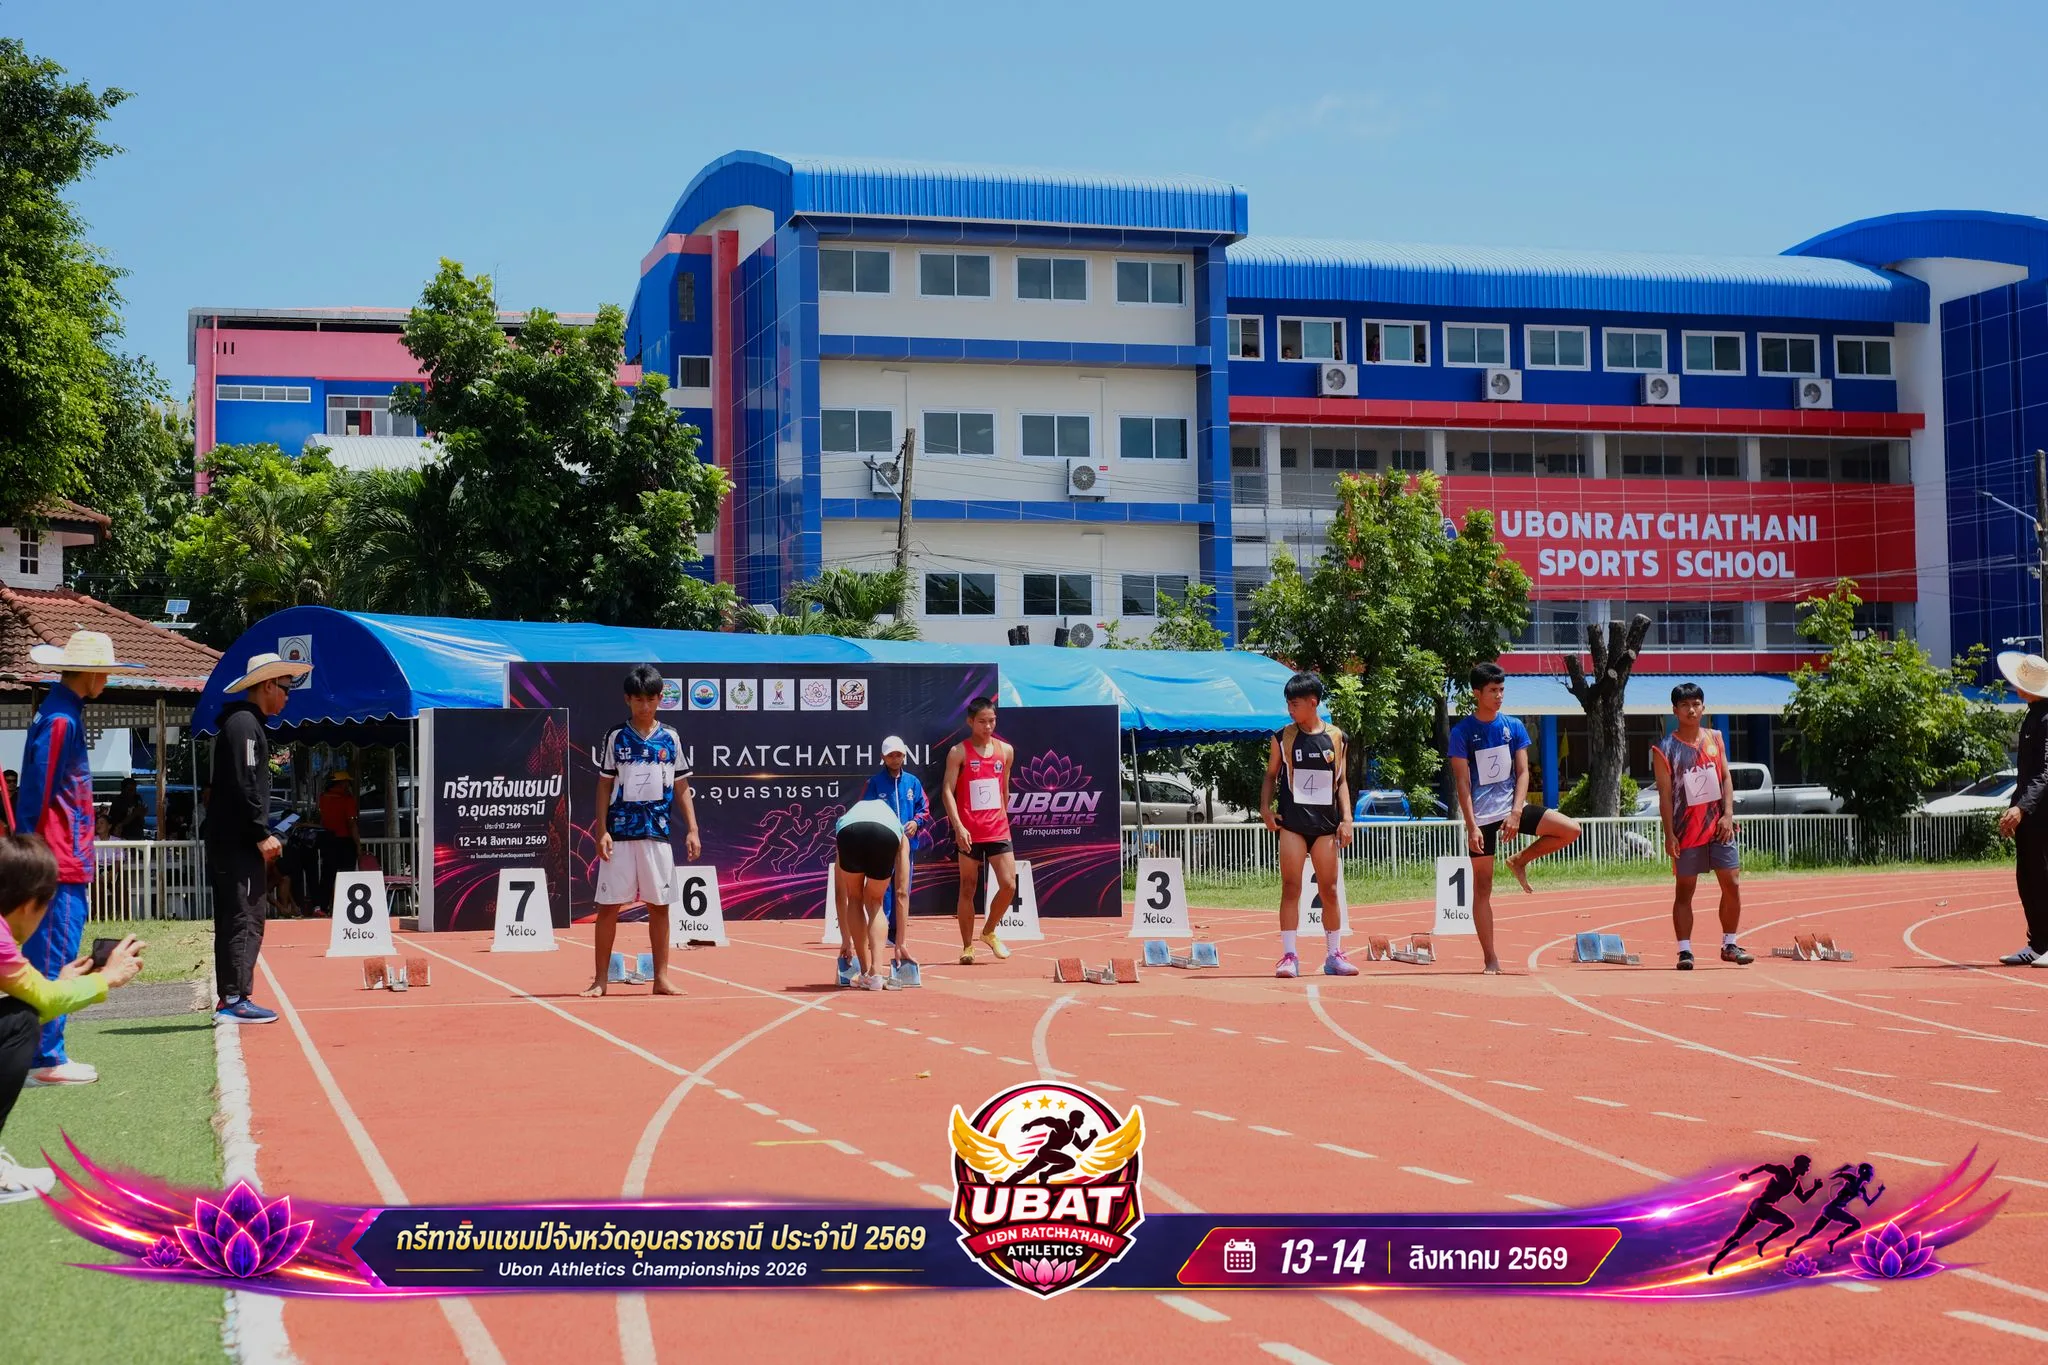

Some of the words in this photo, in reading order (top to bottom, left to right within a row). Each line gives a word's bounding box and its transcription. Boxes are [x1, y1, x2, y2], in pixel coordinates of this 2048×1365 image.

[1501, 510, 1817, 541] UBONRATCHATHANI
[1539, 549, 1659, 577] SPORTS
[1677, 550, 1795, 578] SCHOOL
[713, 745, 930, 767] RATCHATHNI
[1487, 755, 1501, 779] 3
[443, 774, 563, 799] กรีฑาชิงแชมป์
[635, 773, 651, 794] 7
[1302, 774, 1319, 796] 4
[1694, 775, 1708, 797] 2
[978, 785, 992, 805] 5
[1006, 791, 1103, 814] UBON
[457, 800, 546, 821] จ.อุบลราชธานี
[1009, 813, 1099, 826] ATHLETICS
[506, 822, 521, 830] 2569
[490, 835, 523, 846] สิงหาคม
[525, 835, 547, 845] 2569
[682, 876, 708, 917] 6
[1146, 870, 1172, 910] 3
[1448, 867, 1466, 907] 1
[346, 883, 373, 925] 8
[509, 880, 536, 922] 7
[1142, 912, 1173, 924] Nelco
[1442, 908, 1470, 920] Nelco
[342, 927, 375, 940] Nelco
[506, 924, 537, 937] Nelco
[679, 919, 709, 932] Nelco
